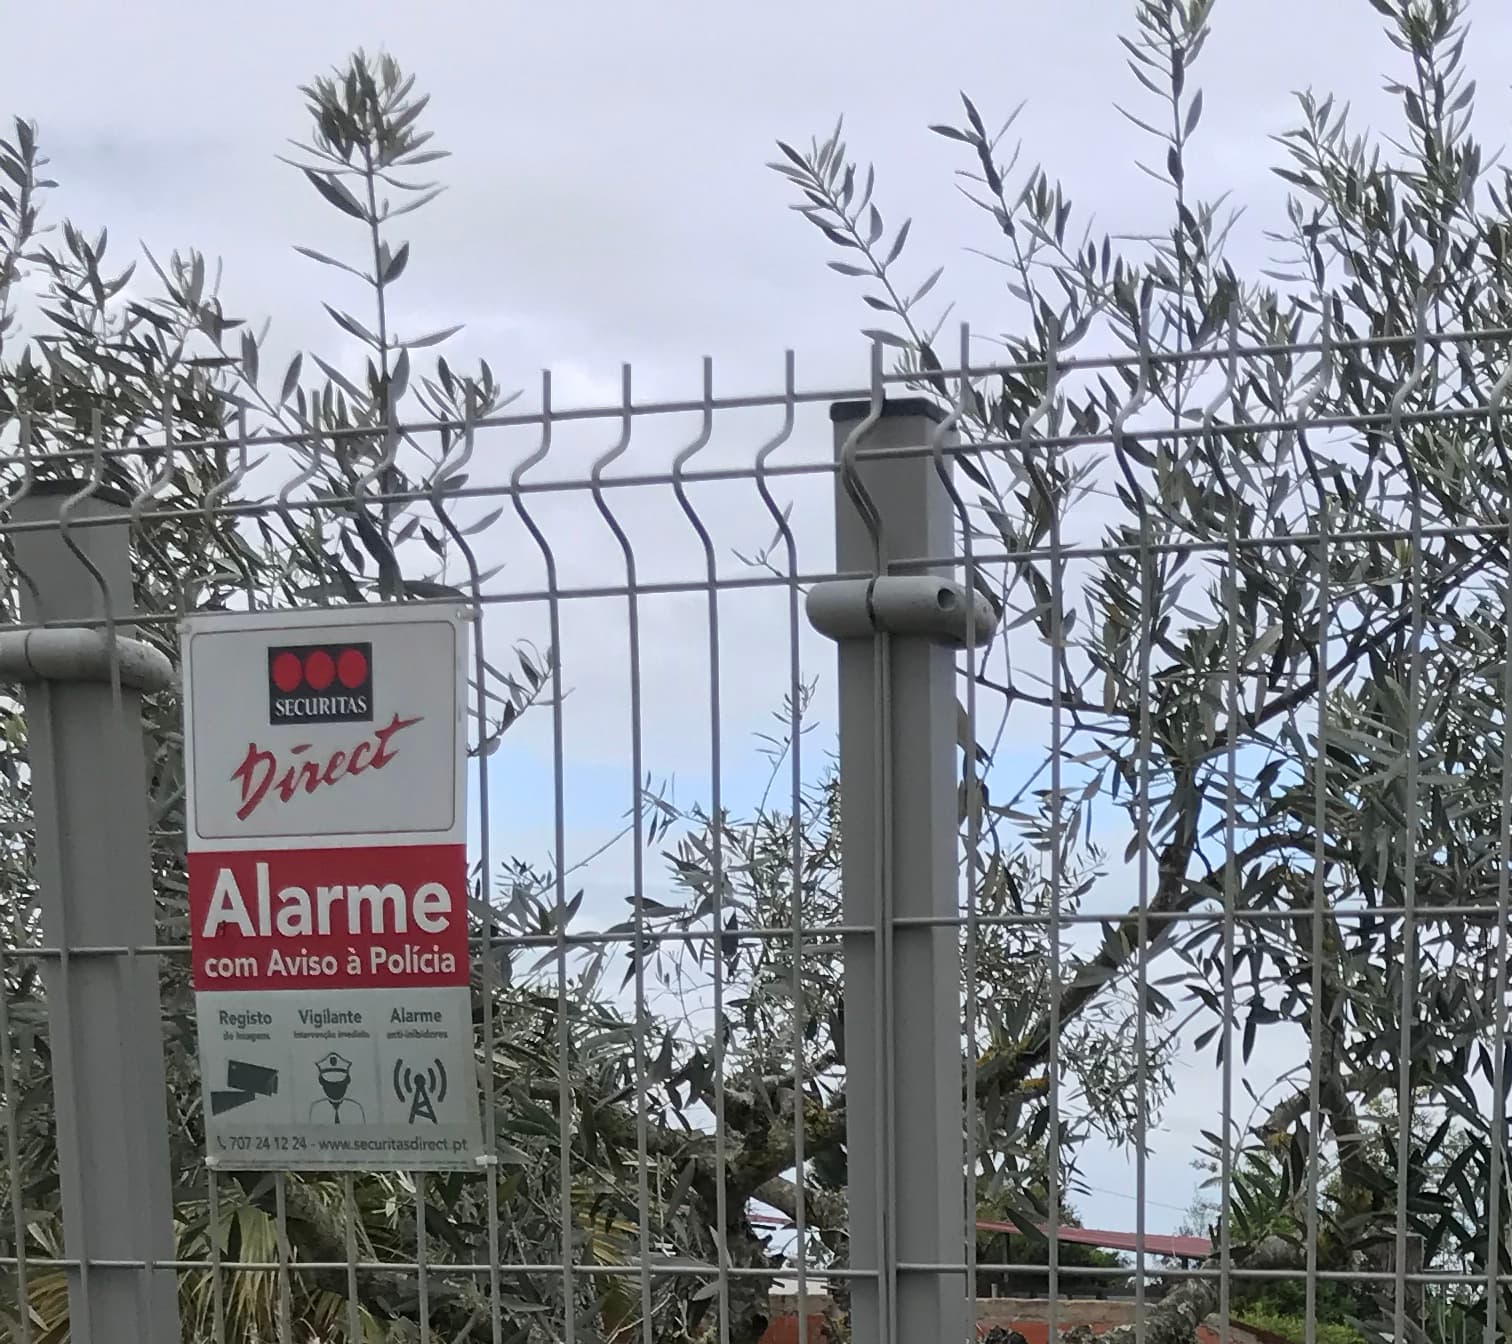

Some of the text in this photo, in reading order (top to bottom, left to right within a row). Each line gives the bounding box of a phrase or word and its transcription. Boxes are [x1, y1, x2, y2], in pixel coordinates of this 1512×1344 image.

[275, 696, 367, 717] SECURITAS
[230, 713, 425, 821] Direct
[202, 862, 452, 938] Alarme
[204, 944, 456, 977] com Aviso à Polícia
[219, 1010, 272, 1029] Registo
[298, 1008, 362, 1028] Vigilante
[390, 1007, 442, 1023] Alarme
[229, 1136, 252, 1150] 707
[255, 1136, 271, 1150] 24
[274, 1136, 288, 1150] 12
[292, 1136, 307, 1150] 24
[318, 1136, 467, 1154] www.securitasdirectpt
